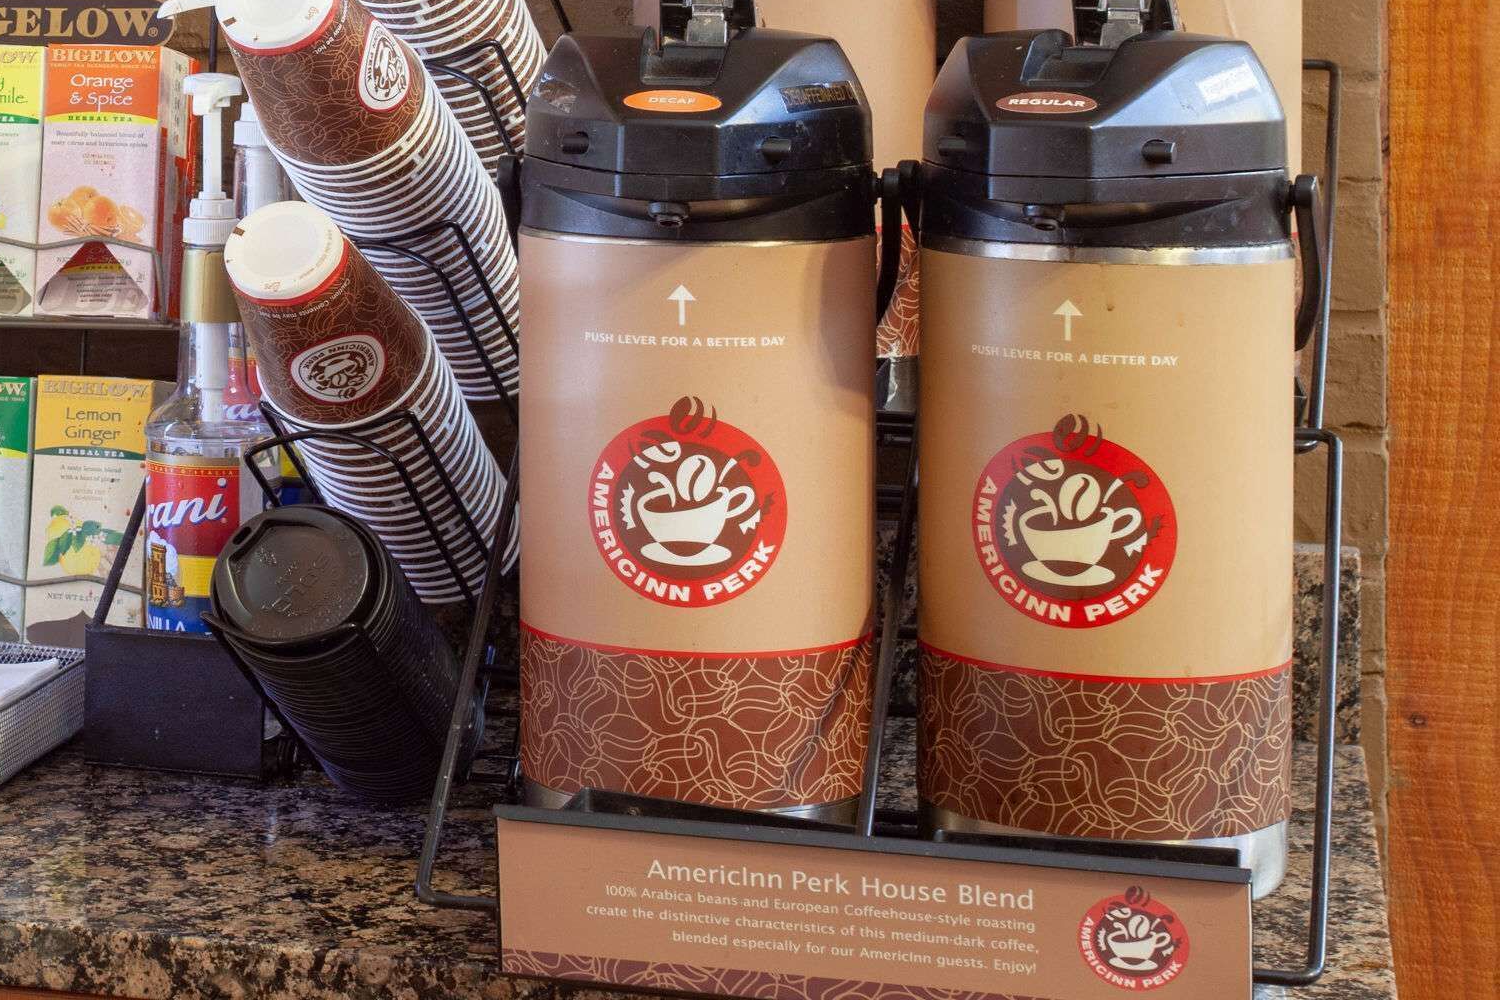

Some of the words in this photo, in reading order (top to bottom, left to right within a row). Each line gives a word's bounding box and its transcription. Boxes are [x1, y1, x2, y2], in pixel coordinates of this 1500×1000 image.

[51, 48, 157, 64] BIGELOW
[70, 73, 134, 94] Orange
[69, 92, 82, 105] &
[86, 92, 133, 113] Spice
[648, 96, 697, 104] DECAF
[1008, 98, 1085, 107] REGULAR
[584, 331, 613, 344] PUSH
[618, 333, 656, 346] LEVER
[661, 336, 688, 347] FOR
[692, 337, 701, 347] A
[707, 337, 756, 347] BETTER
[761, 336, 786, 346] DAY
[972, 344, 999, 356] PUSH
[1003, 347, 1041, 360] LEVER
[1046, 351, 1073, 362] FOR
[1078, 353, 1088, 363] A
[1092, 354, 1146, 366] BETTER
[1151, 356, 1179, 366] DAY
[65, 407, 122, 422] Lemon
[64, 425, 122, 446] Ginger
[58, 448, 100, 456] HERBAL
[593, 461, 690, 602] AMERICINN
[702, 539, 776, 600] PERK
[975, 475, 1072, 623] AMERICINN
[1084, 563, 1164, 622] PERK
[647, 859, 784, 890] AmericInn
[792, 871, 850, 895] Perk
[861, 876, 947, 903] House
[958, 884, 1035, 911] Blend
[605, 885, 638, 898] 100%
[641, 887, 693, 903] Arabica
[697, 891, 738, 907] beans
[743, 896, 770, 909] and
[773, 898, 839, 916] European
[844, 904, 971, 927] Coffeehouse-style
[976, 916, 1036, 934] roasting
[586, 904, 629, 918] create
[632, 906, 654, 920] the
[658, 908, 731, 927] distinctive
[735, 915, 836, 936] characteristics
[840, 924, 855, 937] of
[860, 925, 886, 940] this
[891, 928, 985, 949] medium-dark
[991, 938, 1039, 954] coffee,
[672, 930, 729, 947] blended
[732, 936, 802, 955] especially
[806, 942, 826, 955] for
[830, 945, 855, 958] our
[936, 954, 988, 970] guests.
[994, 958, 1038, 976] Enjoy!
[1080, 916, 1137, 989] AMERICINN
[1142, 960, 1183, 989] PERK
